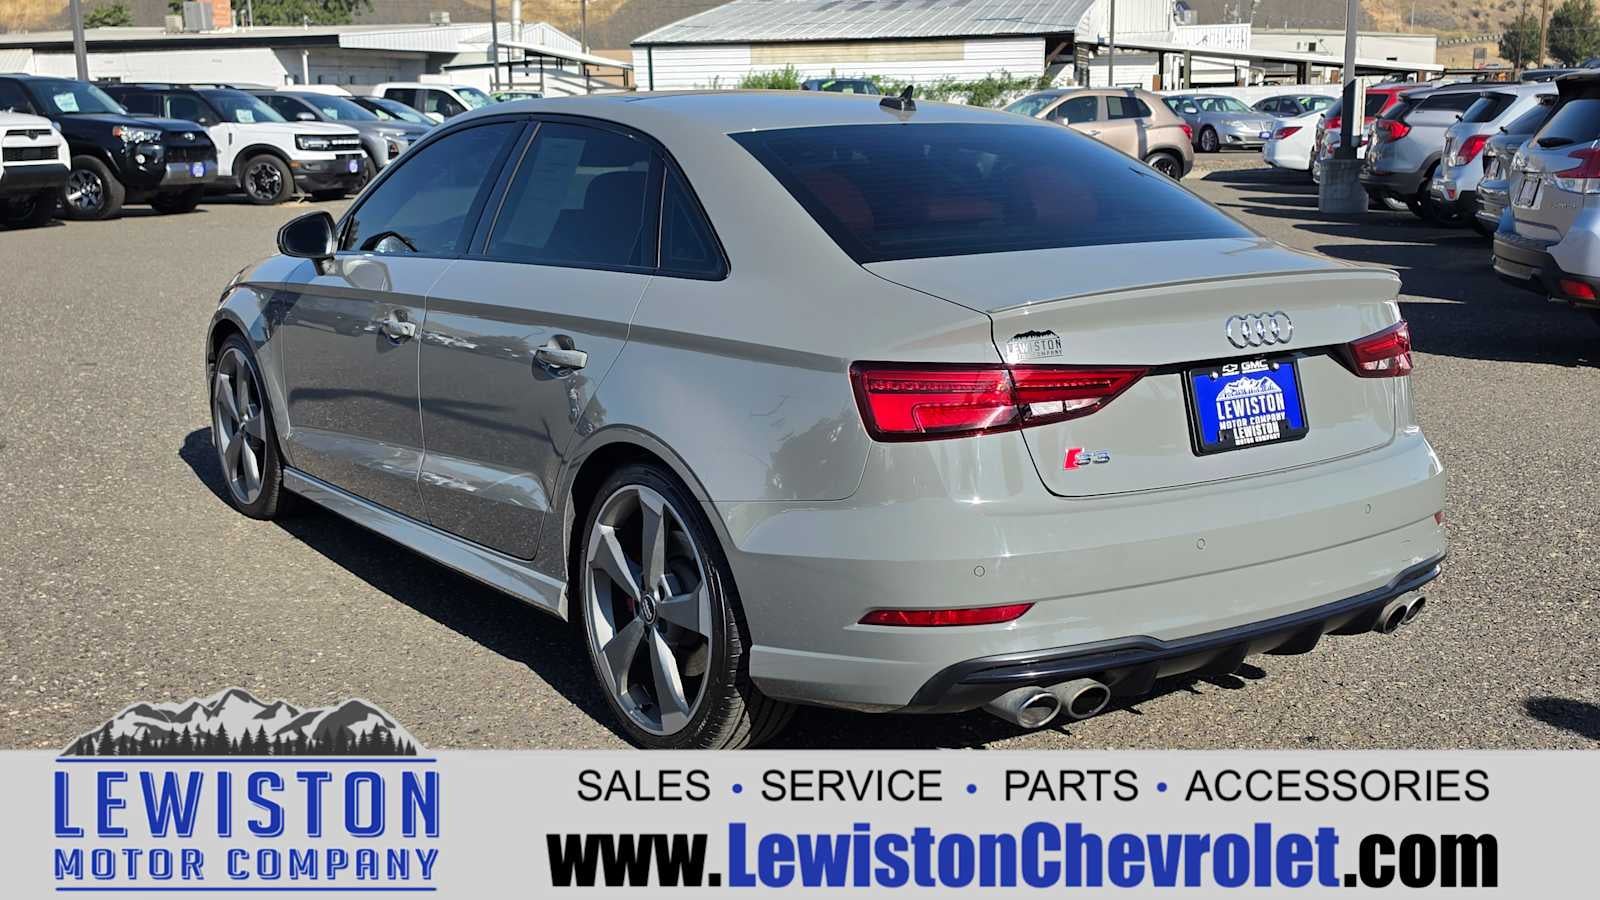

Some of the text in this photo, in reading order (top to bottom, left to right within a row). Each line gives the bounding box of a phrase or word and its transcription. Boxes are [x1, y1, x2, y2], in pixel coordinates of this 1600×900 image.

[1241, 360, 1269, 370] GMC
[1216, 393, 1285, 421] LEWISTON
[1219, 412, 1286, 430] MOTOR COMPANY
[1233, 421, 1280, 440] LEWISTON
